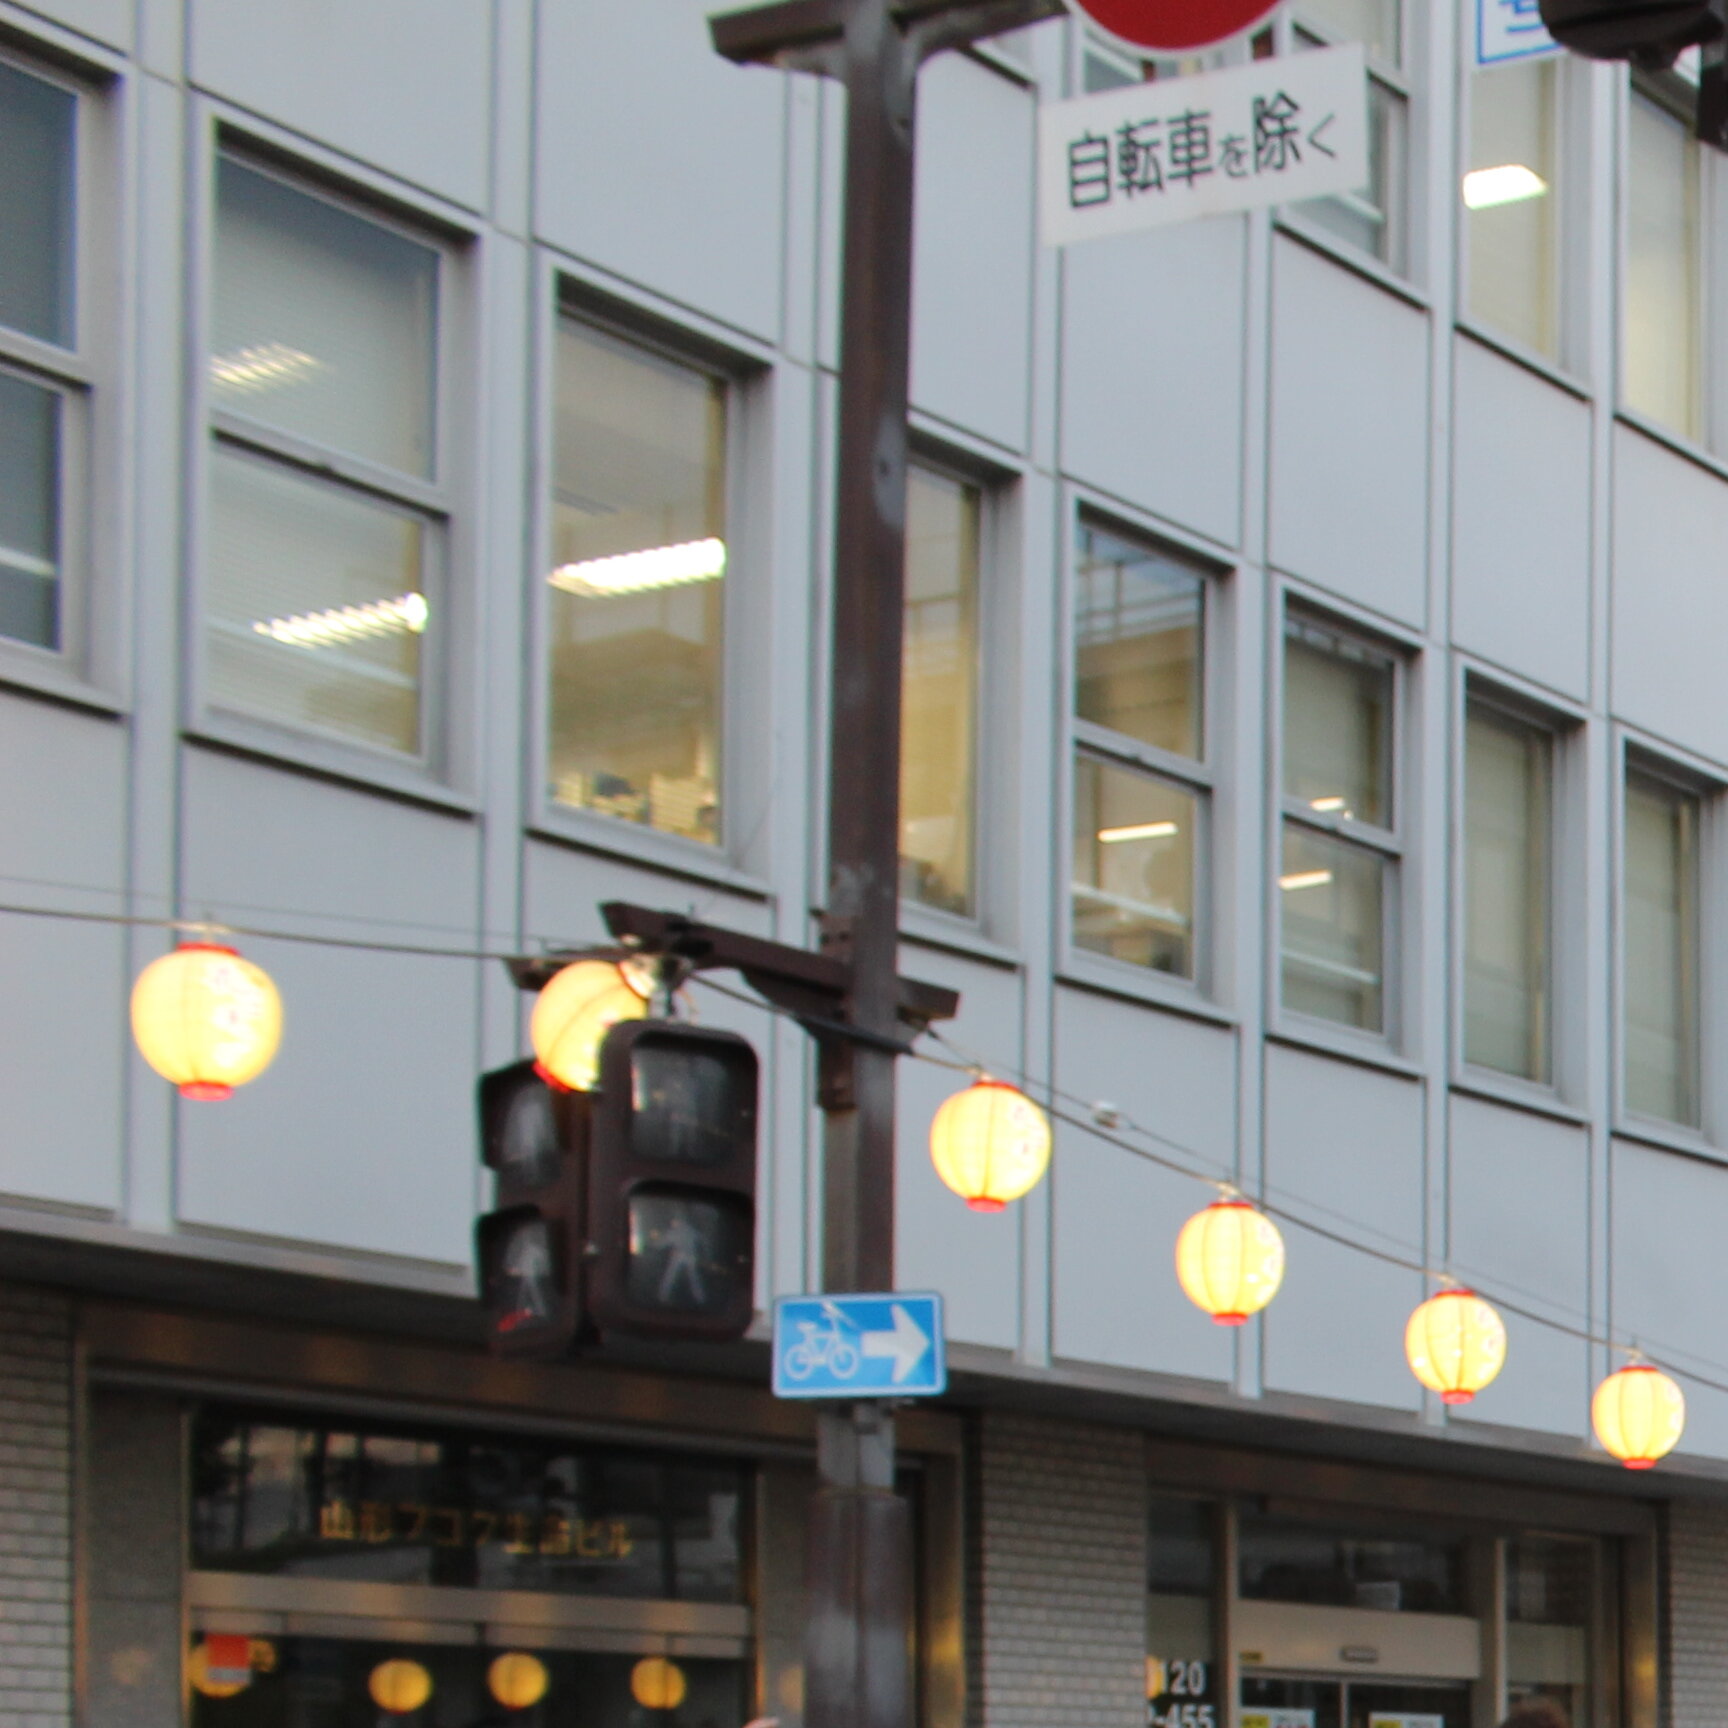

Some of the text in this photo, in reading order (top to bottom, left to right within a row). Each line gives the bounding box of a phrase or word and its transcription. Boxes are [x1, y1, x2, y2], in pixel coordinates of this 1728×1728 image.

[1068, 91, 1337, 208] 自転車を除く
